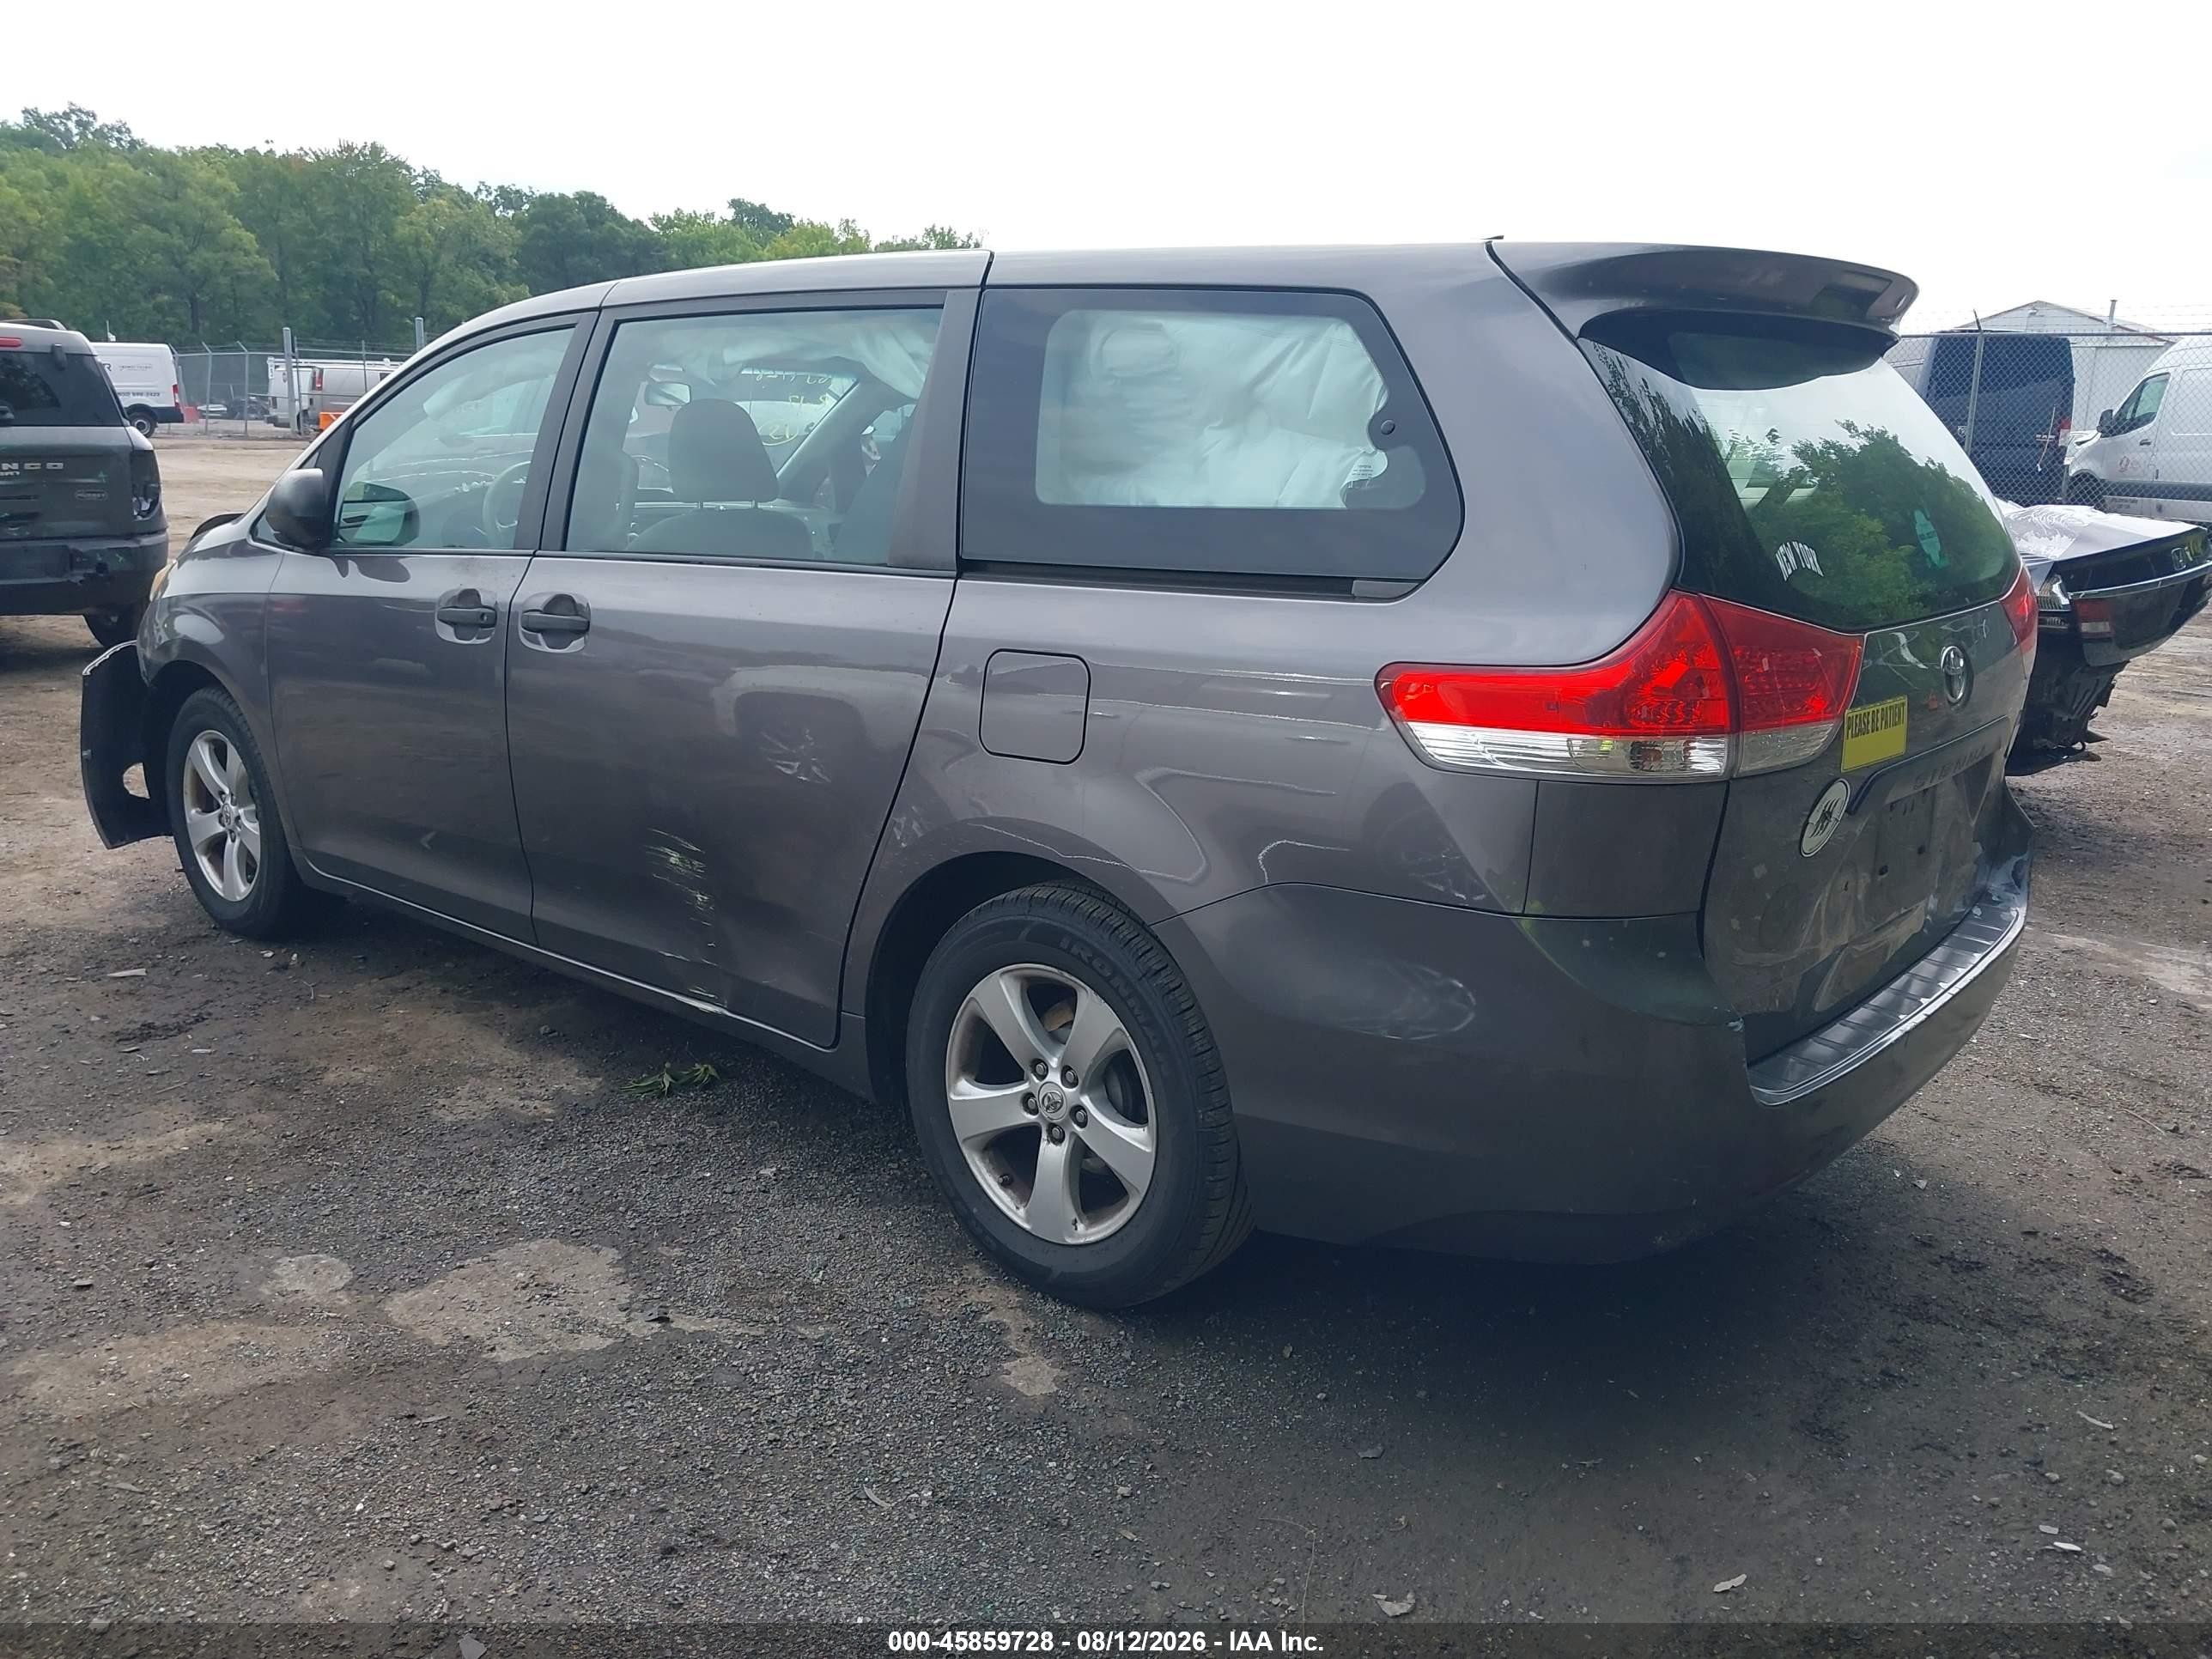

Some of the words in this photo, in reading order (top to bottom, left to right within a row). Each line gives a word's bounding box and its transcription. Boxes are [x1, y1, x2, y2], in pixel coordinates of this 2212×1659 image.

[1776, 542, 1798, 581] NEW
[1792, 541, 1824, 577] YORK
[1846, 711, 1870, 740] PLEASE
[1871, 708, 1880, 733] BE
[1881, 702, 1905, 731] PATIENT
